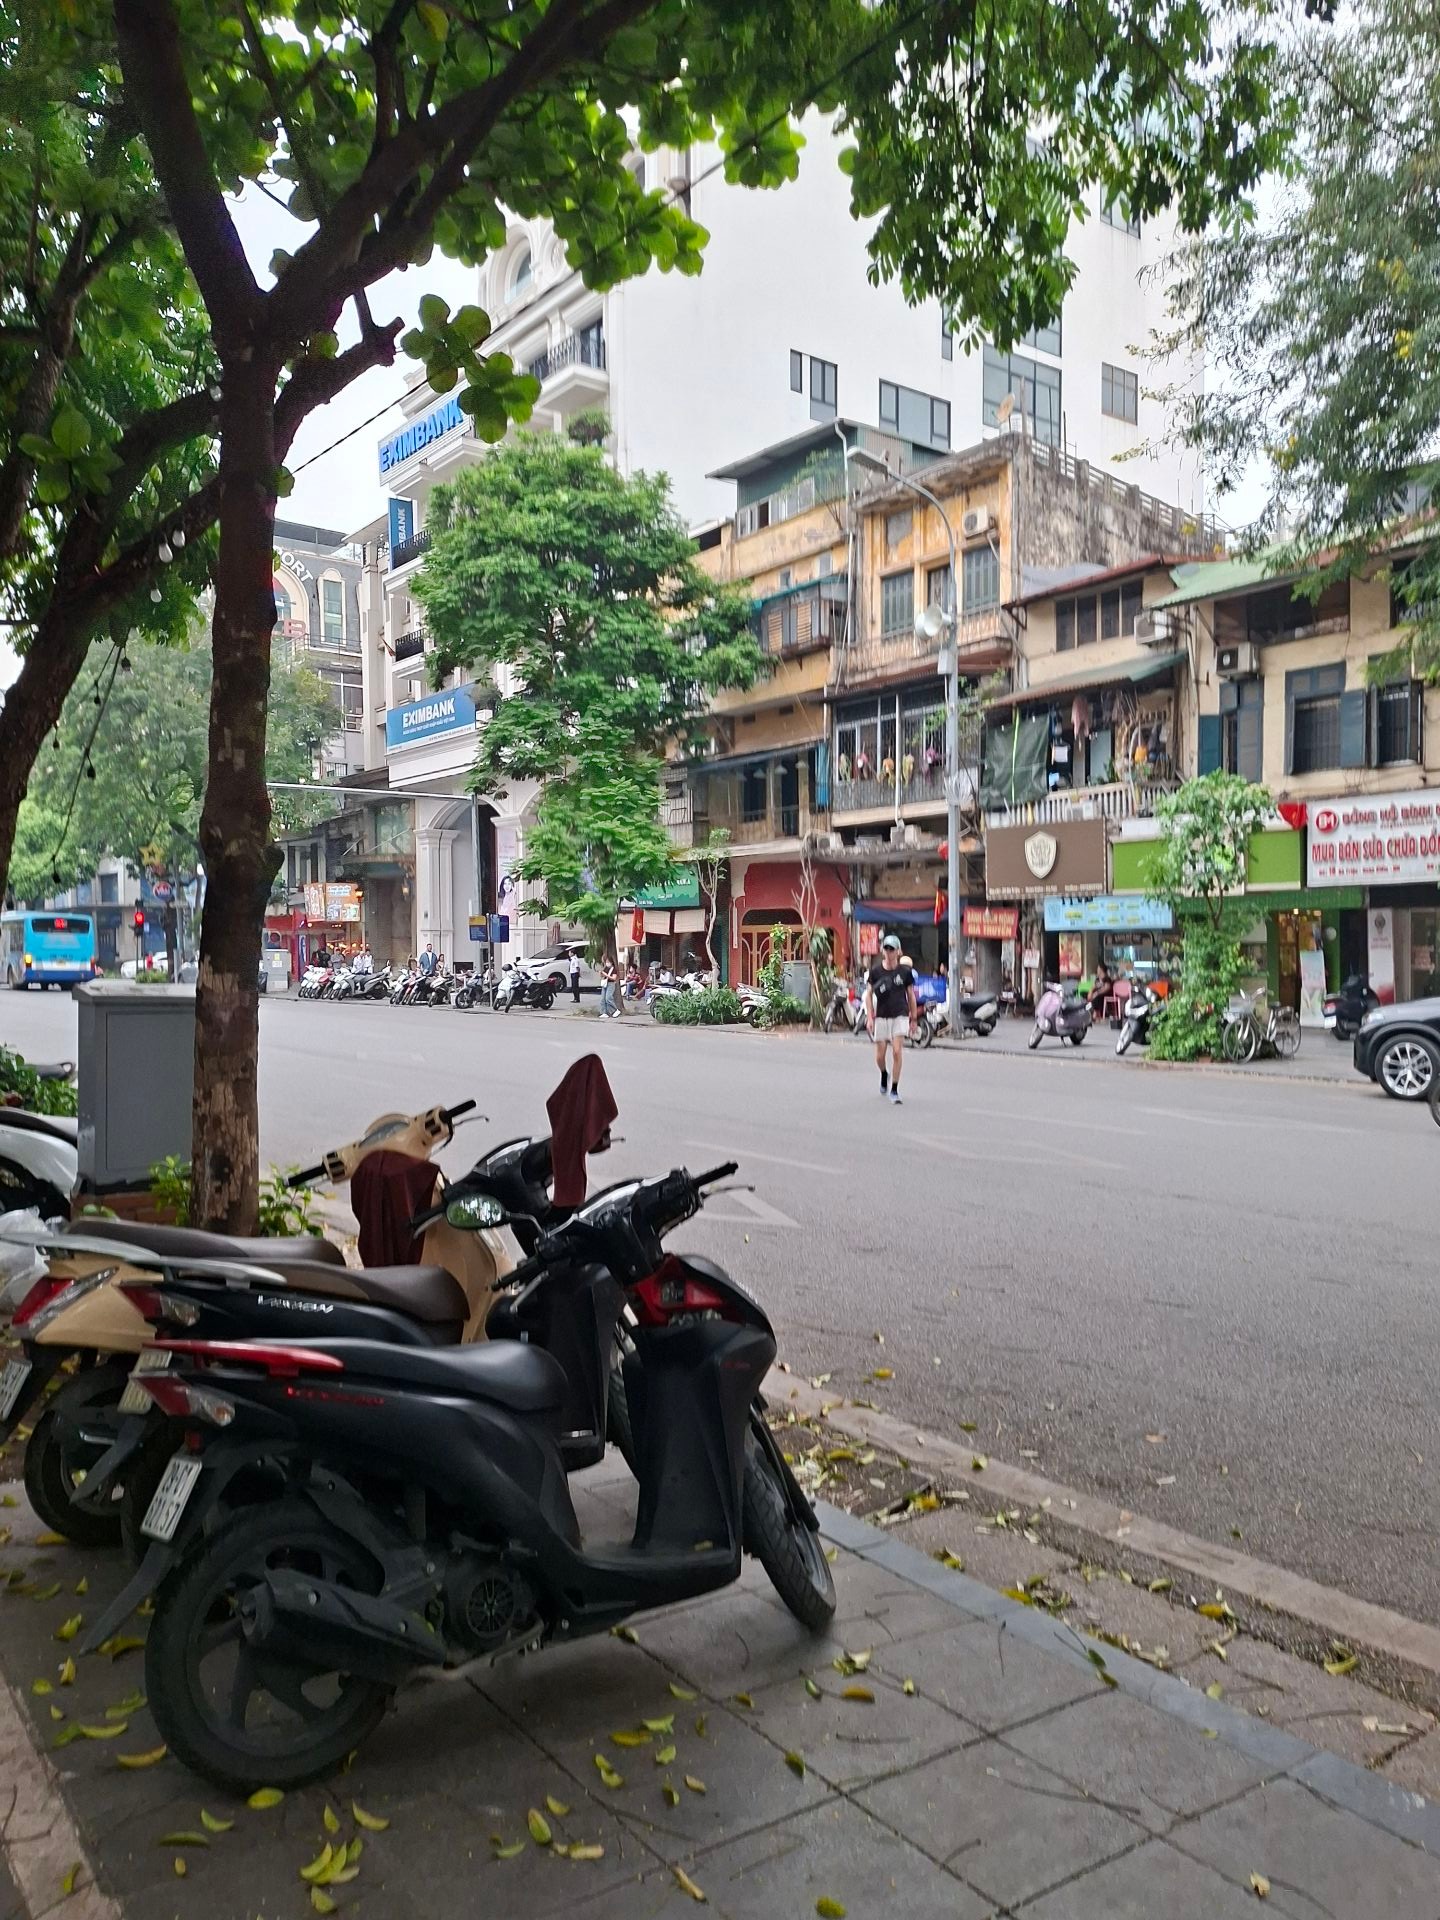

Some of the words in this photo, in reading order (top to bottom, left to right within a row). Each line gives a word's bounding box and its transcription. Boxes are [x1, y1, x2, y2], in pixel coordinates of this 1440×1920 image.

[379, 397, 464, 473] EXIMBANK
[402, 697, 455, 729] EXIMBANK
[1312, 842, 1336, 863] MUA
[1338, 834, 1359, 862] BÁN
